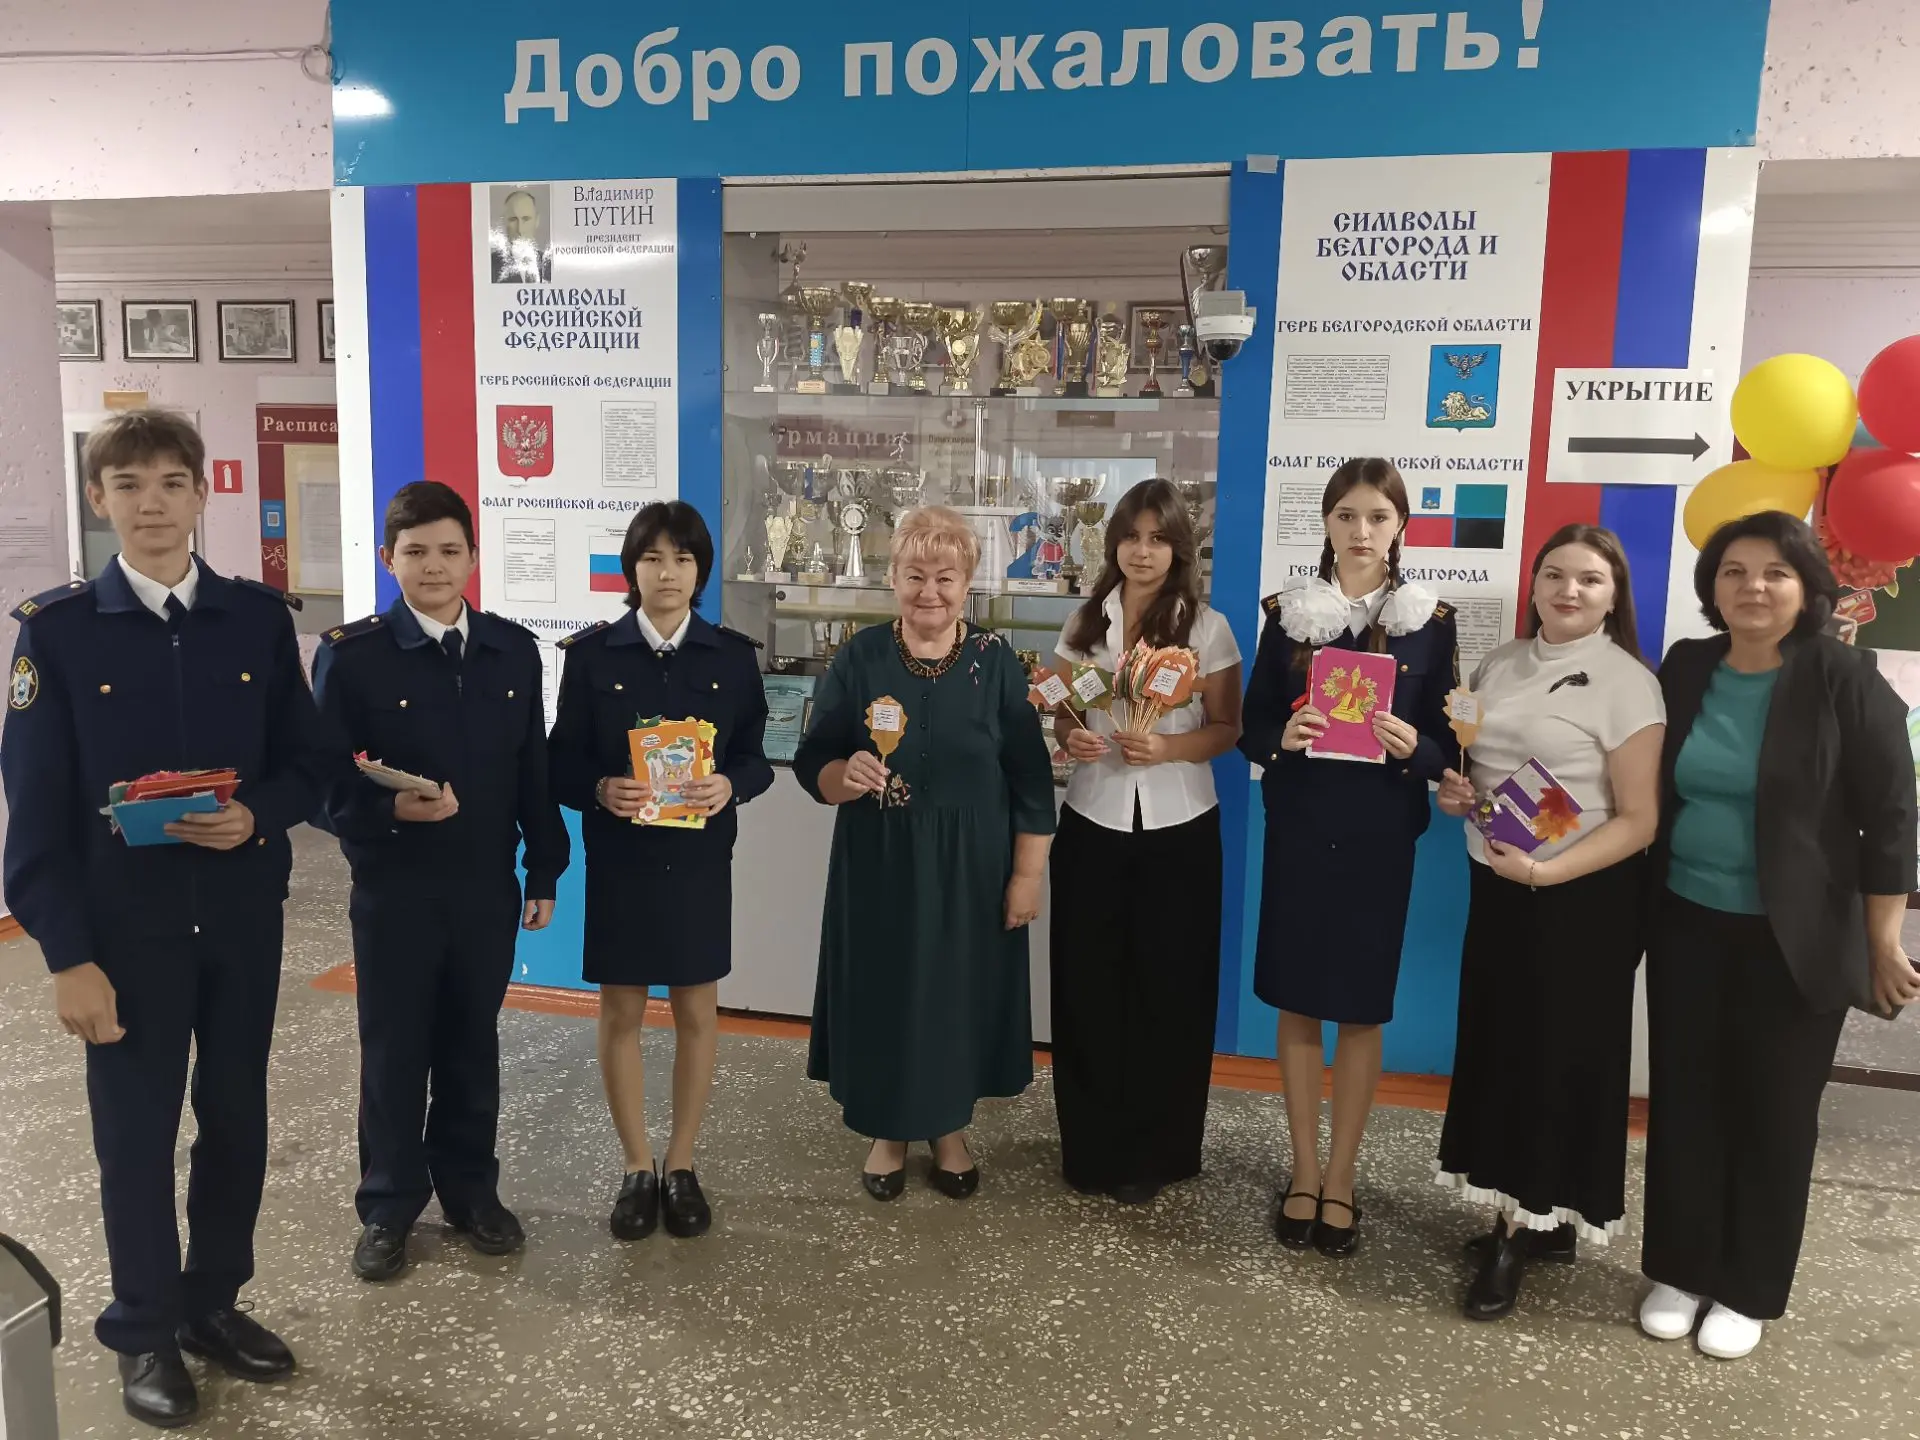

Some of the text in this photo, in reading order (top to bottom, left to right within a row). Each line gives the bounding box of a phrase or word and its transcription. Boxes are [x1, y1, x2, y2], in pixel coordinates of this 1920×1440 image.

[504, 0, 1543, 123] Добро пожаловать!
[574, 186, 653, 204] Владимир
[574, 205, 654, 226] ПУТИН
[1334, 210, 1477, 232] СИМВОЛЫ
[586, 234, 641, 243] ПРЕЗИДЕНТ
[1316, 235, 1499, 259] БЕЛГОРОДА И
[555, 244, 674, 255] РОССИЙСКОЙ ФЕДЕРАЦИИ
[1341, 261, 1468, 281] ОБЛАСТИ
[516, 288, 626, 306] СИМВОЛЫ
[502, 306, 642, 328] РОССИЙСКОЙ
[1278, 317, 1532, 334] ГЕРБ БЕЛГОРОДСКОЙ ОБЛАСТИ
[504, 331, 640, 353] ФЕДЕРАЦИИ
[480, 374, 672, 389] ГЕРБ РОССИЙСКОЙ ФЕДЕРАЦИИ
[1566, 381, 1713, 402] УКРЫТИЕ
[263, 416, 338, 433] Расписа
[1268, 455, 1313, 468] ФЛАГ
[1446, 457, 1524, 471] ОБЛАСТИ
[482, 496, 514, 508] ФЛАГ
[517, 497, 594, 510] РОССИЙСКОЙ
